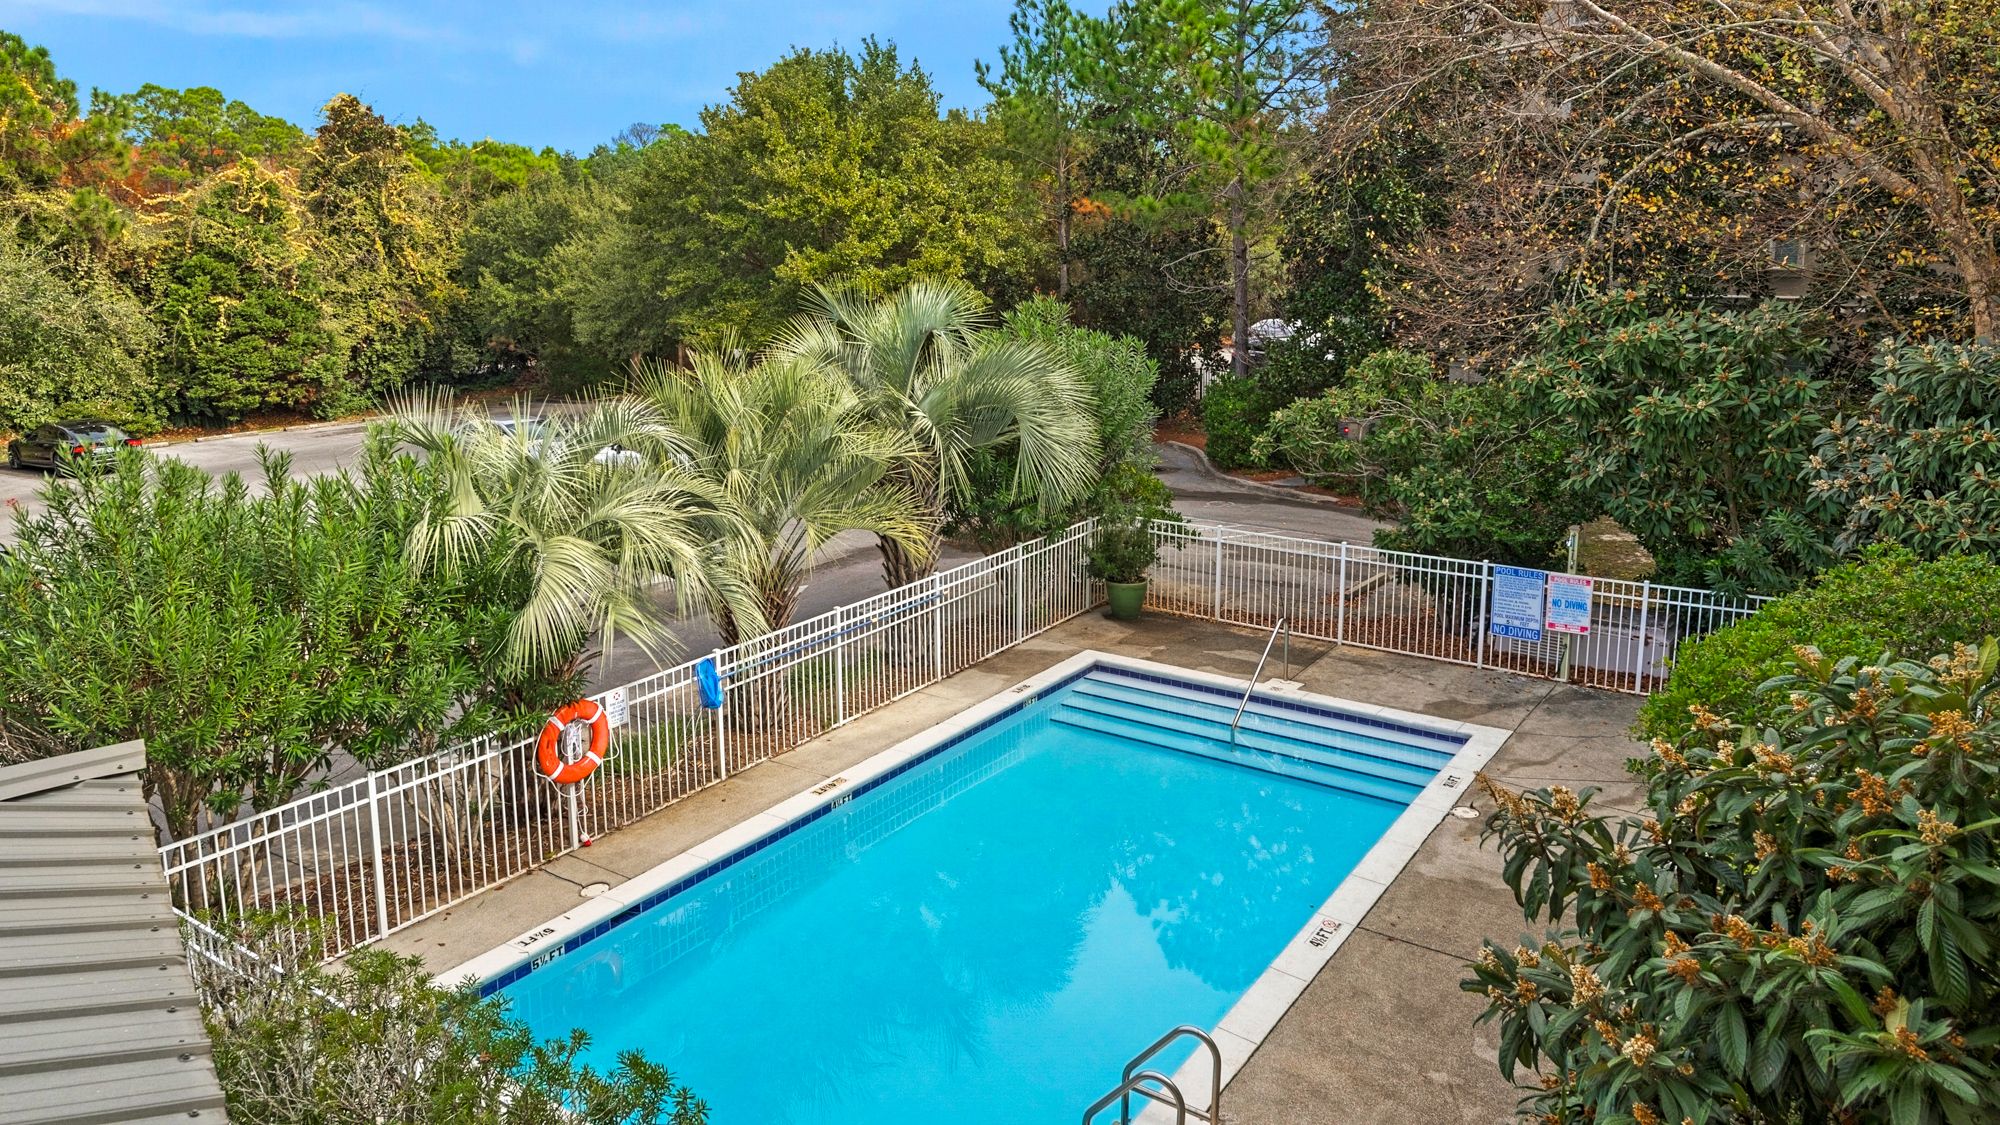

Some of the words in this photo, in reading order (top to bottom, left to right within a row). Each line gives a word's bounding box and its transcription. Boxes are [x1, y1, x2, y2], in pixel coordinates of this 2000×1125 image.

[1495, 567, 1515, 576] POOL
[1518, 569, 1543, 579] RULES
[1552, 598, 1562, 608] NO
[1565, 600, 1588, 611] DIVING
[1493, 624, 1505, 635] NO
[1508, 626, 1538, 640] DIVING
